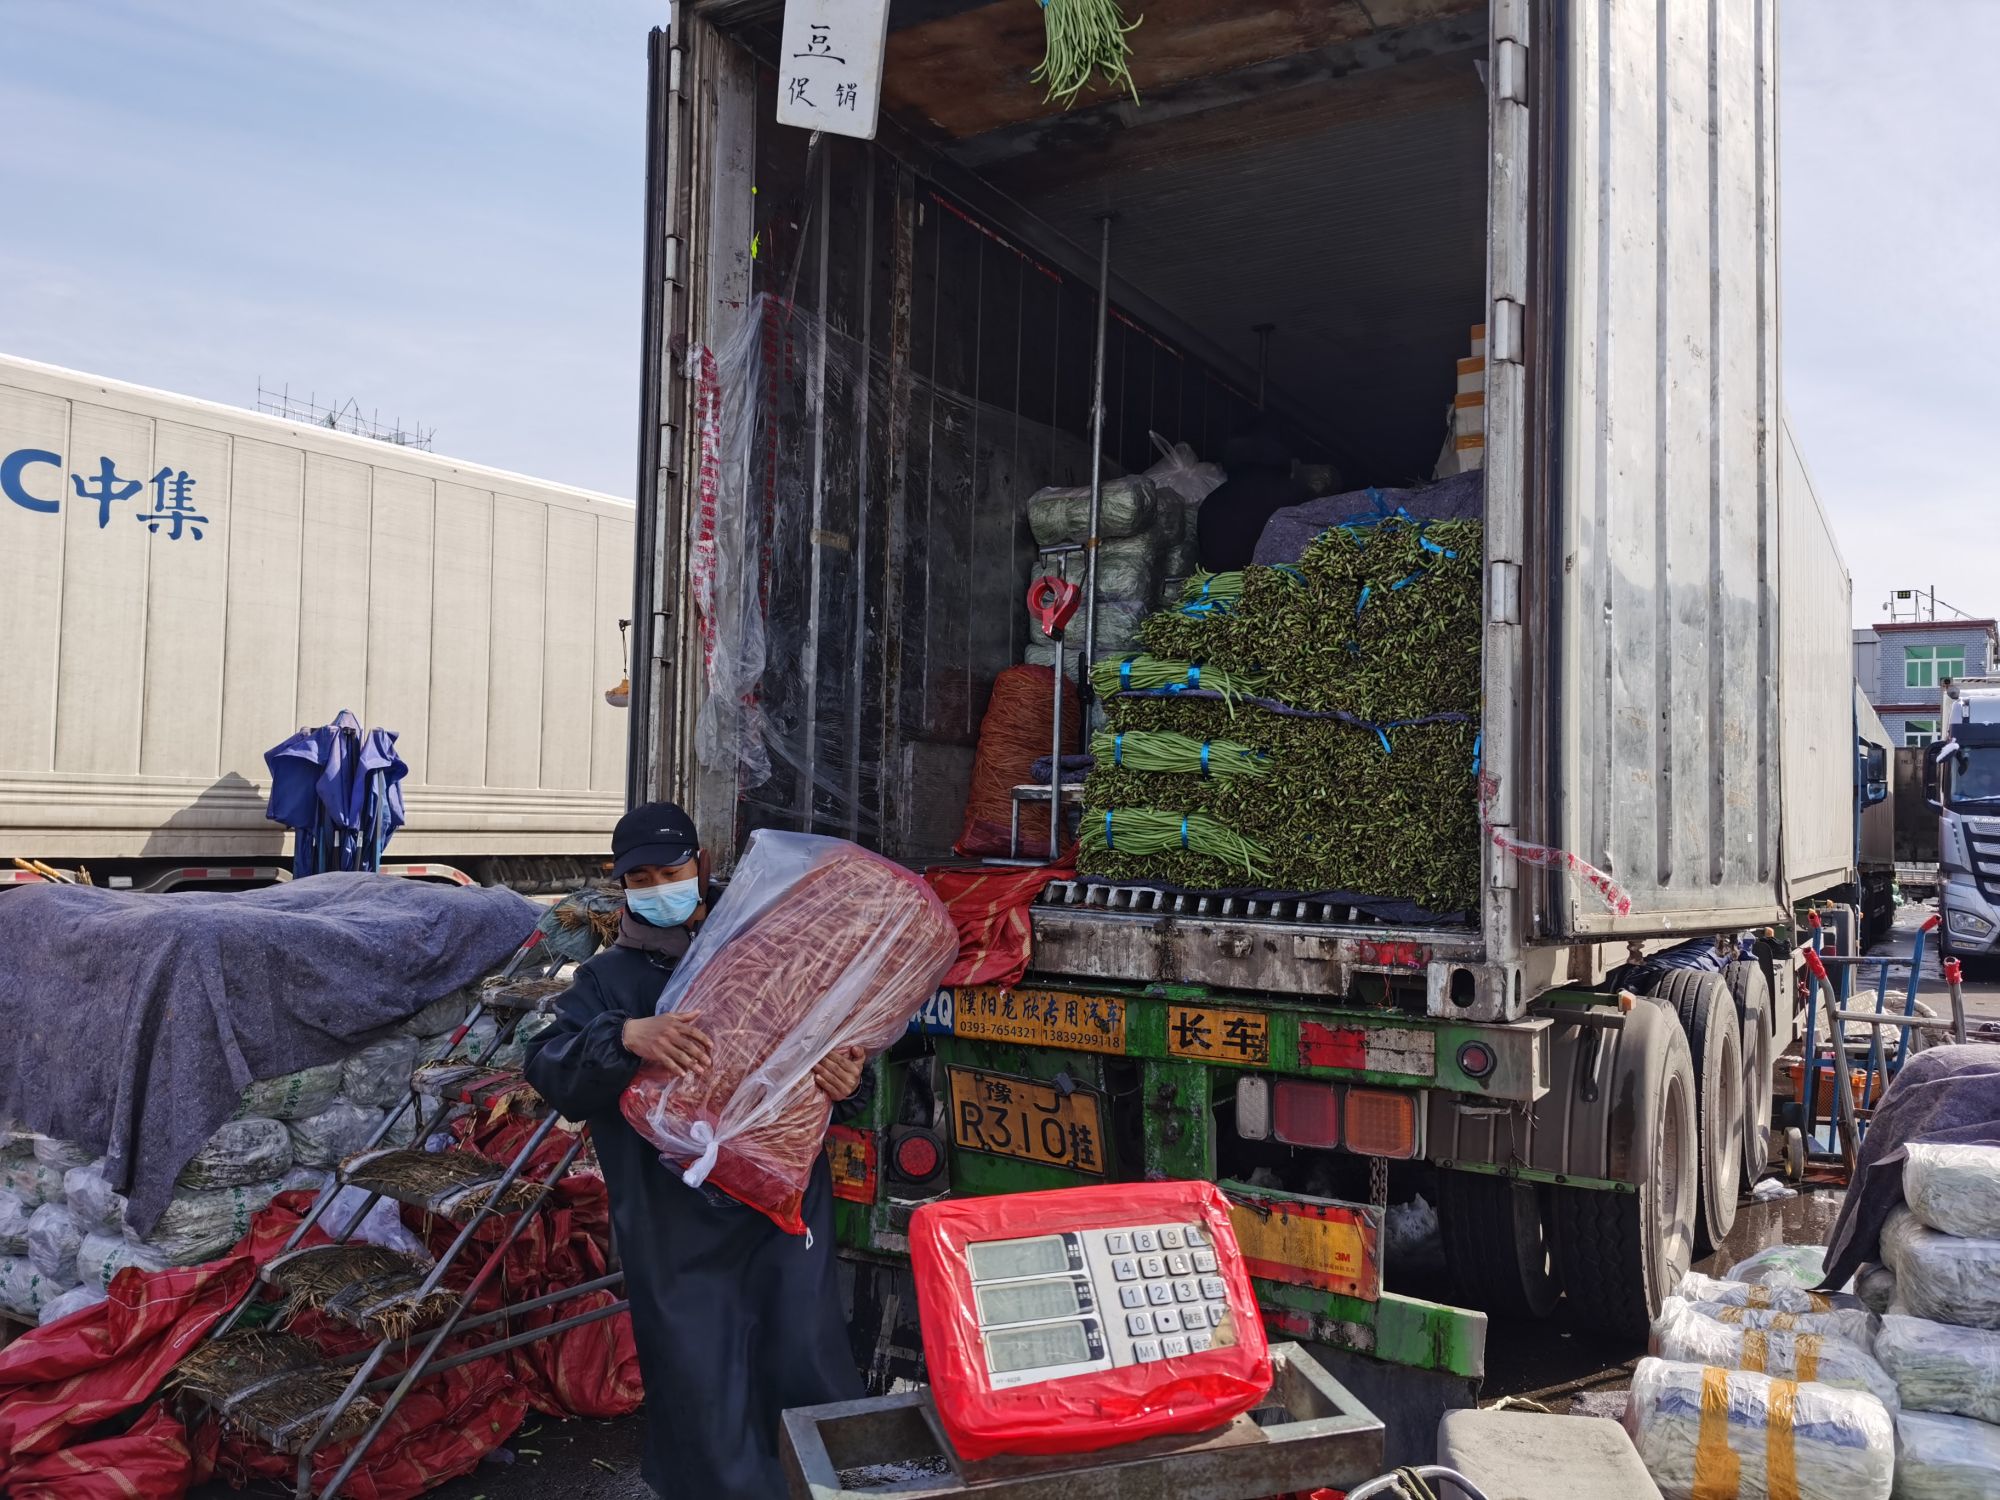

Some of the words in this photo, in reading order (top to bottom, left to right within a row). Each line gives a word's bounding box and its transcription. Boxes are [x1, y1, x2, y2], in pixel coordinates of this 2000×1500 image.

[793, 24, 846, 64] 豆
[788, 77, 858, 112] 促销
[71, 456, 209, 541] 中集
[960, 1020, 1036, 1039] 0393-7654321
[1043, 1029, 1120, 1048] 13839299118
[1172, 1012, 1264, 1056] 长车
[960, 1100, 1096, 1166] R310挂
[1113, 1235, 1122, 1246] 7
[1141, 1235, 1151, 1248] 8
[1167, 1231, 1177, 1245] 9
[1122, 1262, 1131, 1275] 4
[1149, 1259, 1159, 1272] 5
[1175, 1256, 1184, 1269] 6
[1334, 1251, 1351, 1263] 3M
[1128, 1289, 1136, 1303] 1
[1154, 1286, 1165, 1300] 2
[1181, 1283, 1191, 1298] 3
[1135, 1316, 1145, 1331] 0
[1139, 1344, 1156, 1359] M1
[1166, 1341, 1184, 1355] M2
